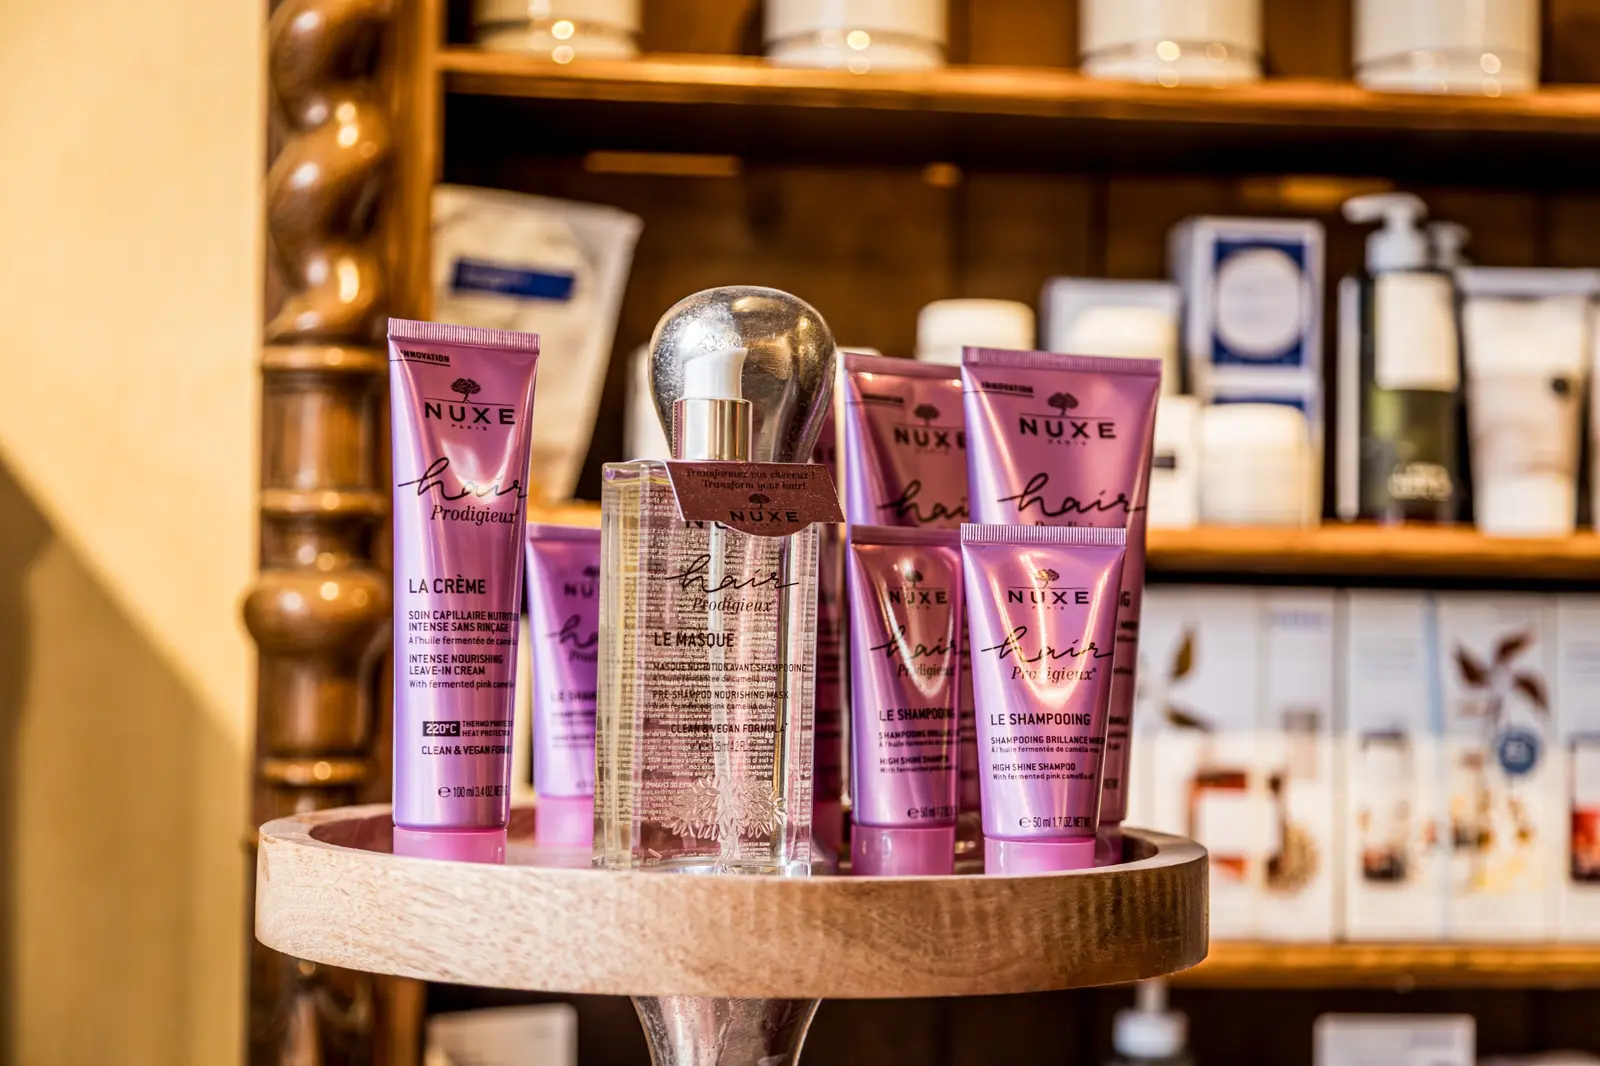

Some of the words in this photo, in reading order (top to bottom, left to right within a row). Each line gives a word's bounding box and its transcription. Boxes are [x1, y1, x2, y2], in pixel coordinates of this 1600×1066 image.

[424, 402, 515, 425] NUXE
[1019, 417, 1117, 440] NUXE
[893, 427, 967, 449] NUXE
[398, 457, 528, 500] hair
[997, 472, 1147, 517] hair
[877, 480, 970, 523] hai
[729, 511, 800, 523] NUXE
[665, 554, 799, 593] hair
[409, 579, 429, 594] LA
[433, 574, 487, 595] CRÈME
[1008, 590, 1089, 605] NUXE
[691, 598, 773, 615] Prodigieux
[409, 610, 430, 621] SOIN
[433, 610, 486, 621] CAPILLAIRE
[409, 622, 449, 632] INTENSE
[451, 622, 475, 632] SANS
[477, 623, 509, 635] RINÇAGE
[443, 636, 485, 645] fermentée
[654, 632, 672, 647] LE
[676, 632, 735, 648] MASQUE
[980, 625, 1114, 663] hair
[409, 654, 449, 664] INTENSE
[451, 654, 503, 664] NOURISHING
[409, 665, 451, 675] LEAVE-IN
[454, 665, 485, 675] CREAM
[409, 680, 427, 688] With
[429, 680, 475, 688] fermented
[476, 680, 492, 690] pink
[714, 690, 765, 699] NOURISHING
[990, 714, 1005, 726] LE
[1009, 713, 1091, 726] SHAMPOOING
[711, 724, 740, 733] VEGAN
[991, 736, 1044, 745] SHAMPOOING
[1046, 736, 1088, 744] BRILLANCE
[421, 745, 452, 755] CLEAN
[453, 745, 462, 755] &
[463, 745, 490, 755] VEGAN
[1018, 745, 1054, 753] fermentée
[992, 763, 1010, 771] HIGH
[1012, 763, 1037, 771] SHINE
[1038, 762, 1076, 771] SHAMPOO
[1046, 773, 1061, 781] pink
[1032, 817, 1042, 828] 50
[1043, 817, 1051, 828] ml
